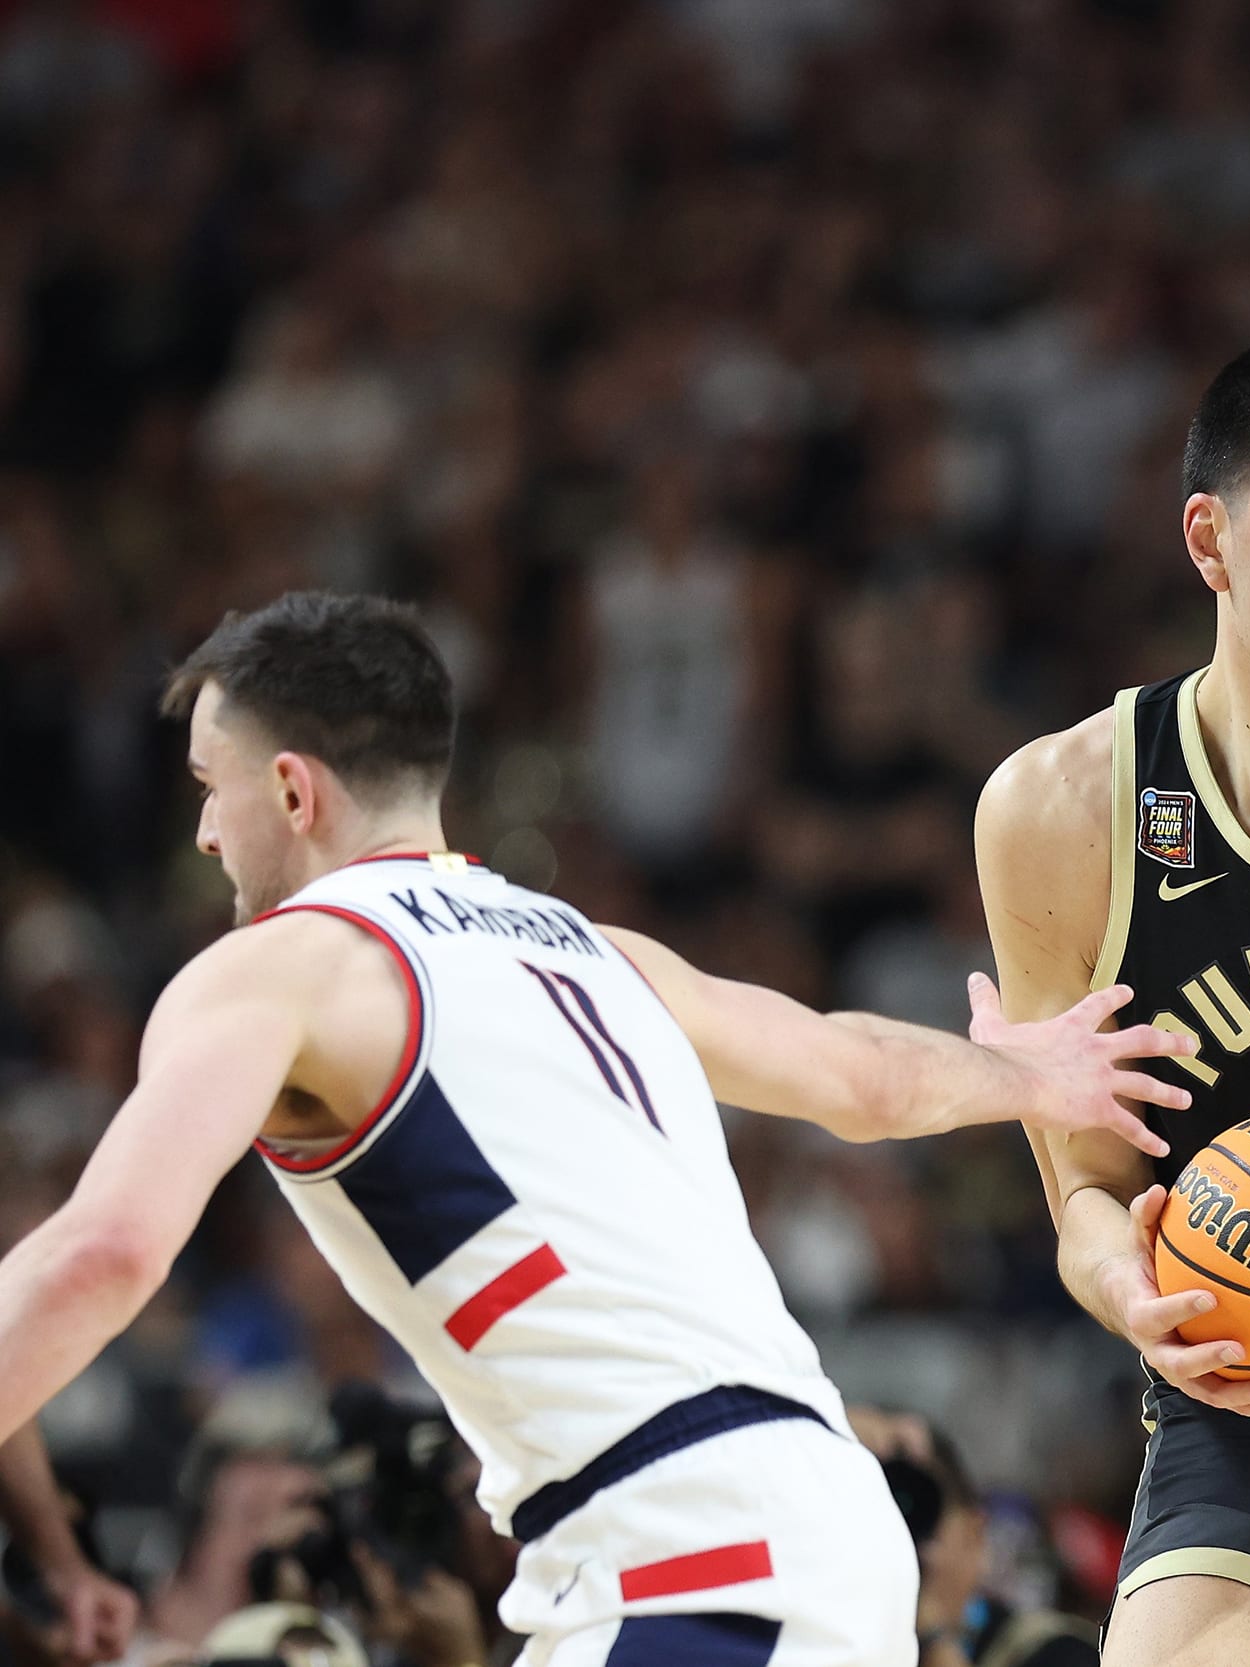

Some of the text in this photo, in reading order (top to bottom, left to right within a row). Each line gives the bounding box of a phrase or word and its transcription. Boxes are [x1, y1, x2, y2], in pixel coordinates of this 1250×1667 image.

[1149, 806, 1183, 822] FINAL
[1148, 821, 1183, 836] FOUR
[515, 957, 671, 1141] 11
